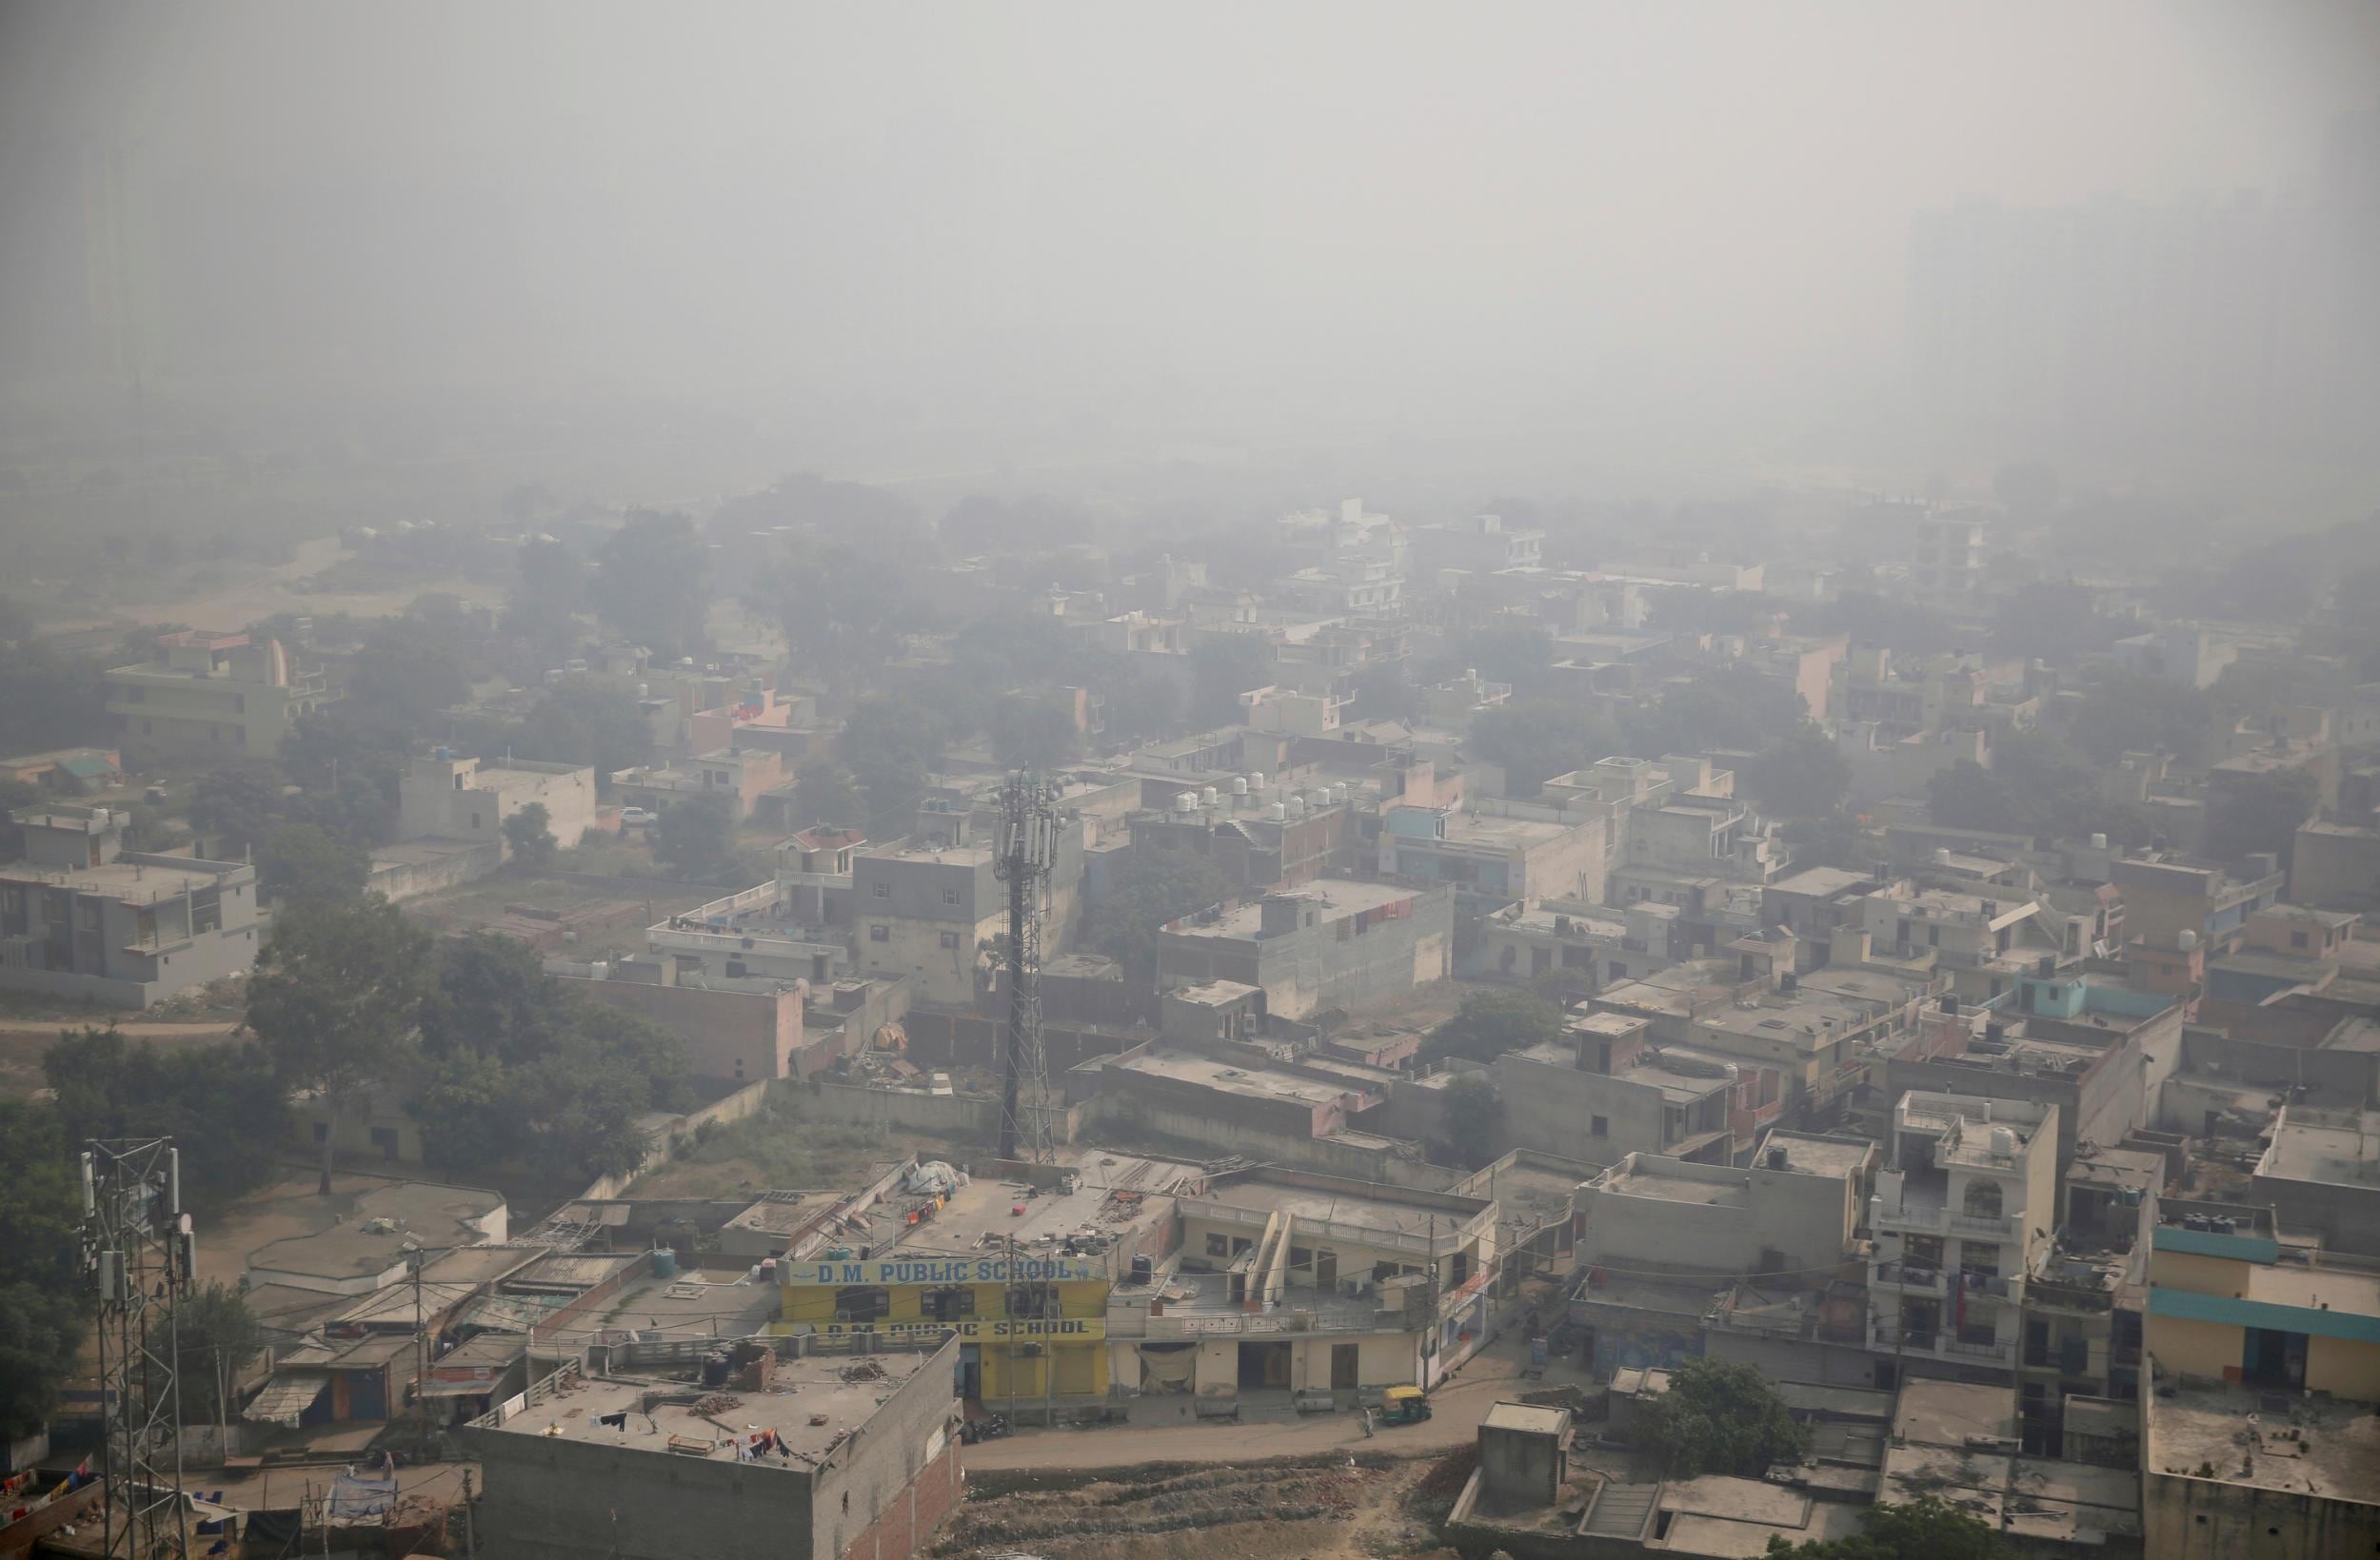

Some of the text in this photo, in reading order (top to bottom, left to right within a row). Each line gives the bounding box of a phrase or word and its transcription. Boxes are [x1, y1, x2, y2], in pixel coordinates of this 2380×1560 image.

[818, 1260, 1072, 1283] D.M. PUBLIC SCHOOL
[993, 1320, 1090, 1335] SCHOOL
